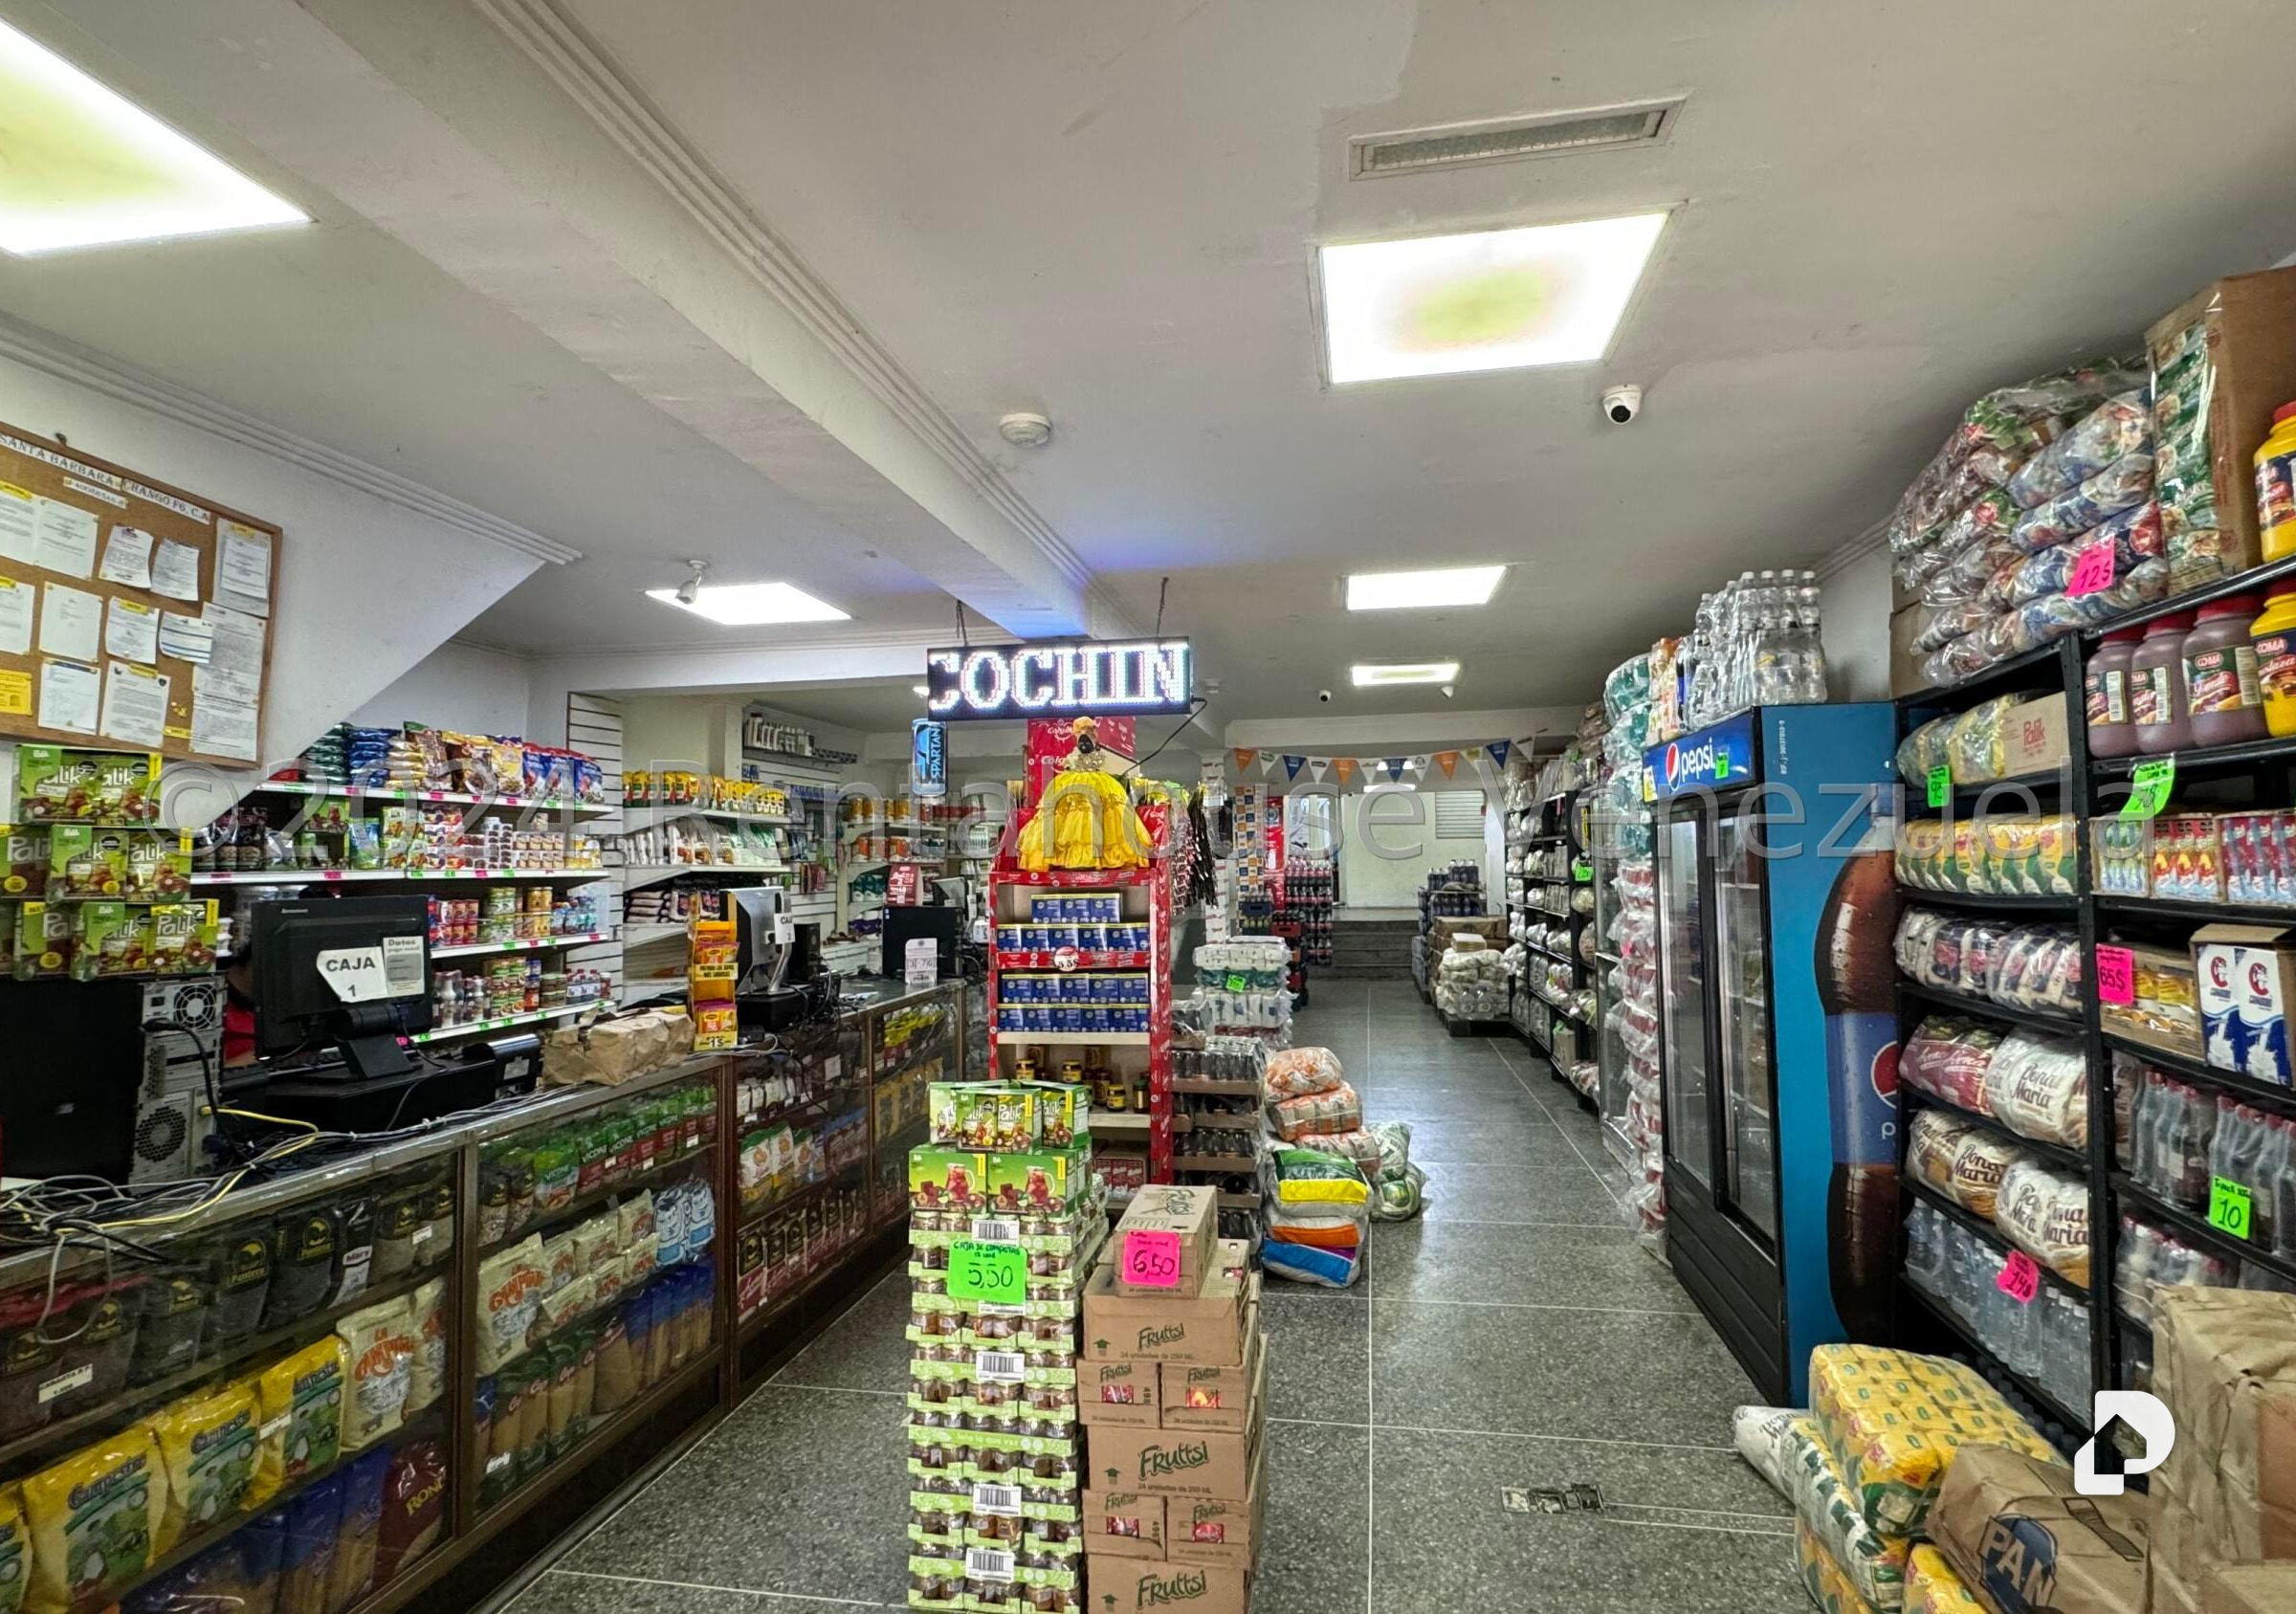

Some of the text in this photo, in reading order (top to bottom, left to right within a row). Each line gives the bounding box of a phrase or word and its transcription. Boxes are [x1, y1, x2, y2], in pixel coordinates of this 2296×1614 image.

[931, 728, 942, 780] SPARTAN
[1681, 737, 1713, 783] pepsi
[387, 939, 416, 947] Datos
[325, 957, 376, 972] CAJA
[347, 984, 357, 997] 1
[2219, 1199, 2241, 1229] 10
[968, 1262, 1013, 1289] 5,50
[1137, 1441, 1210, 1481] Fruttsi
[1978, 1515, 2056, 1611] PAN
[1137, 1570, 1208, 1609] Fruttsi
